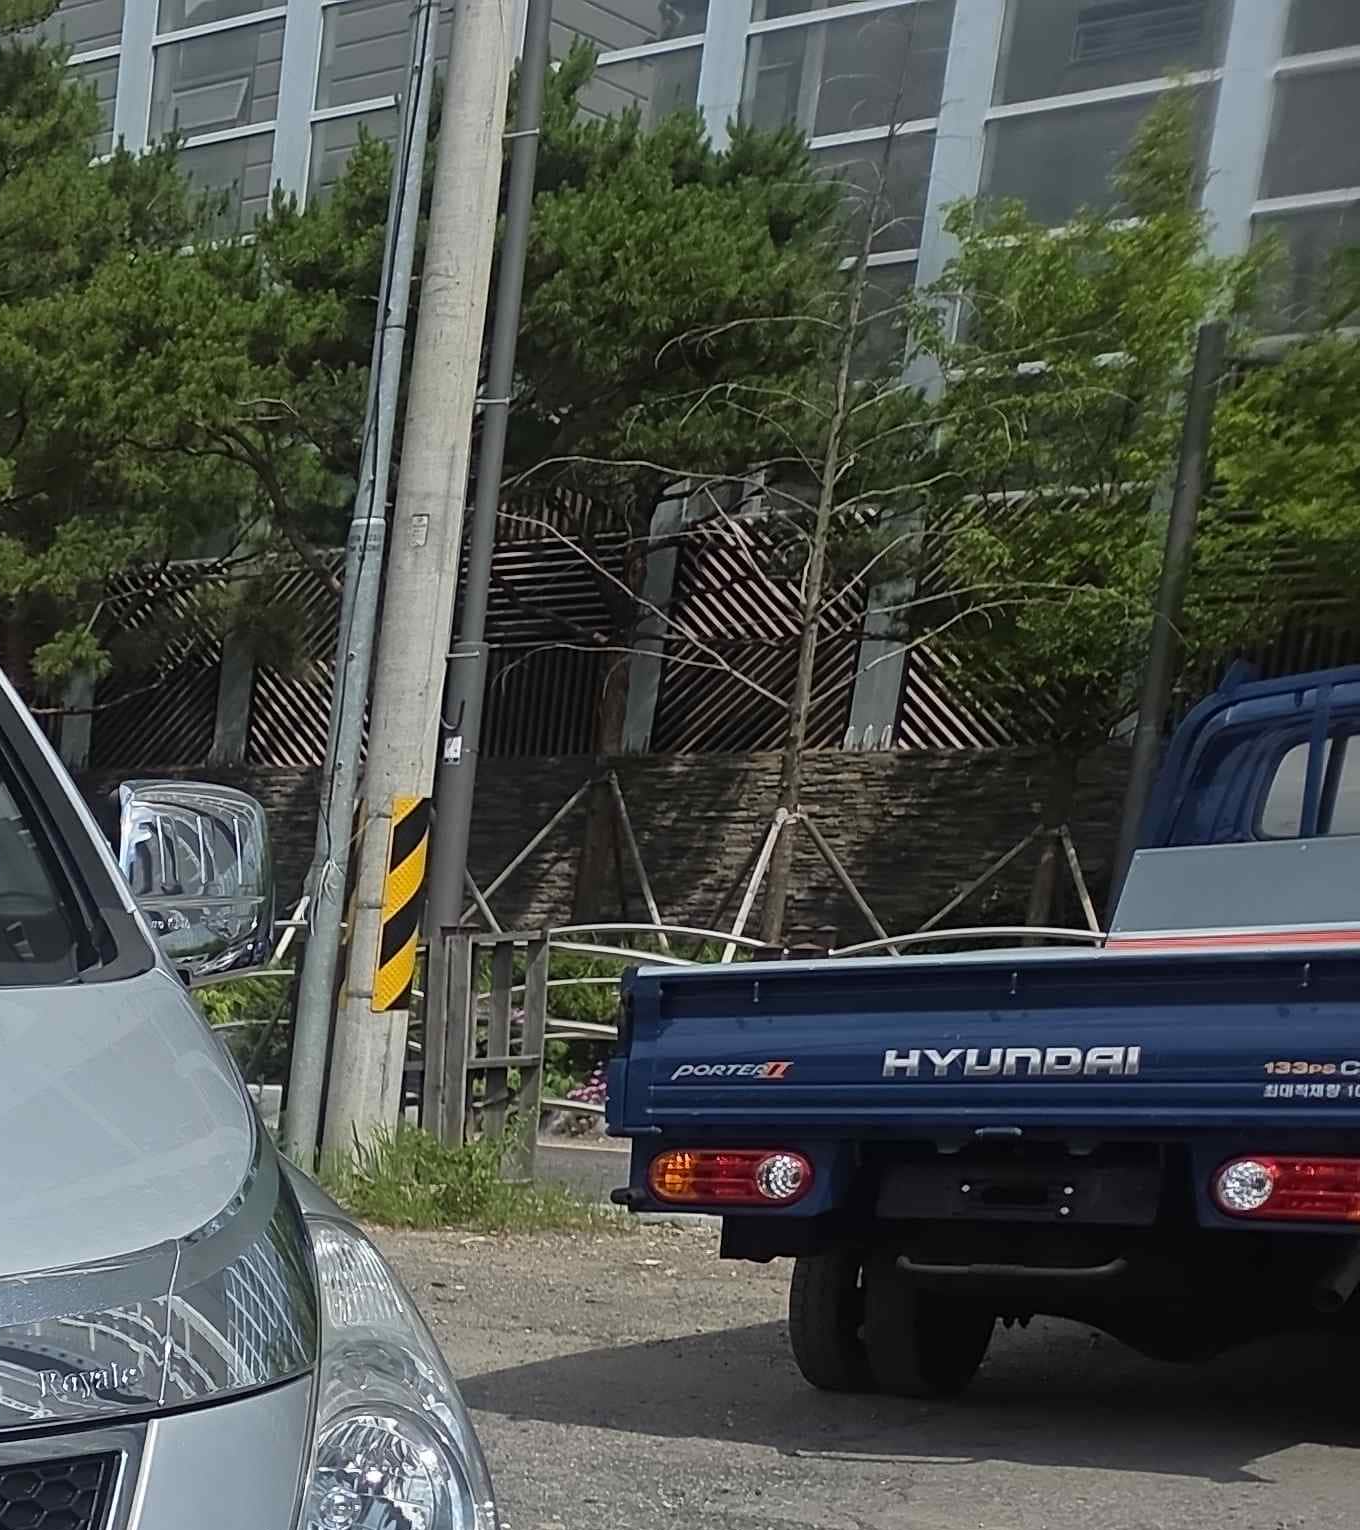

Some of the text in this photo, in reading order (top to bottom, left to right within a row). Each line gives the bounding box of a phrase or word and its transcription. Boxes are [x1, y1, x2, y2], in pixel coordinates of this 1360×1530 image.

[882, 1046, 1141, 1077] HYUNDAI
[1264, 1084, 1340, 1098] 최대적재량
[40, 1362, 142, 1400] Royale
